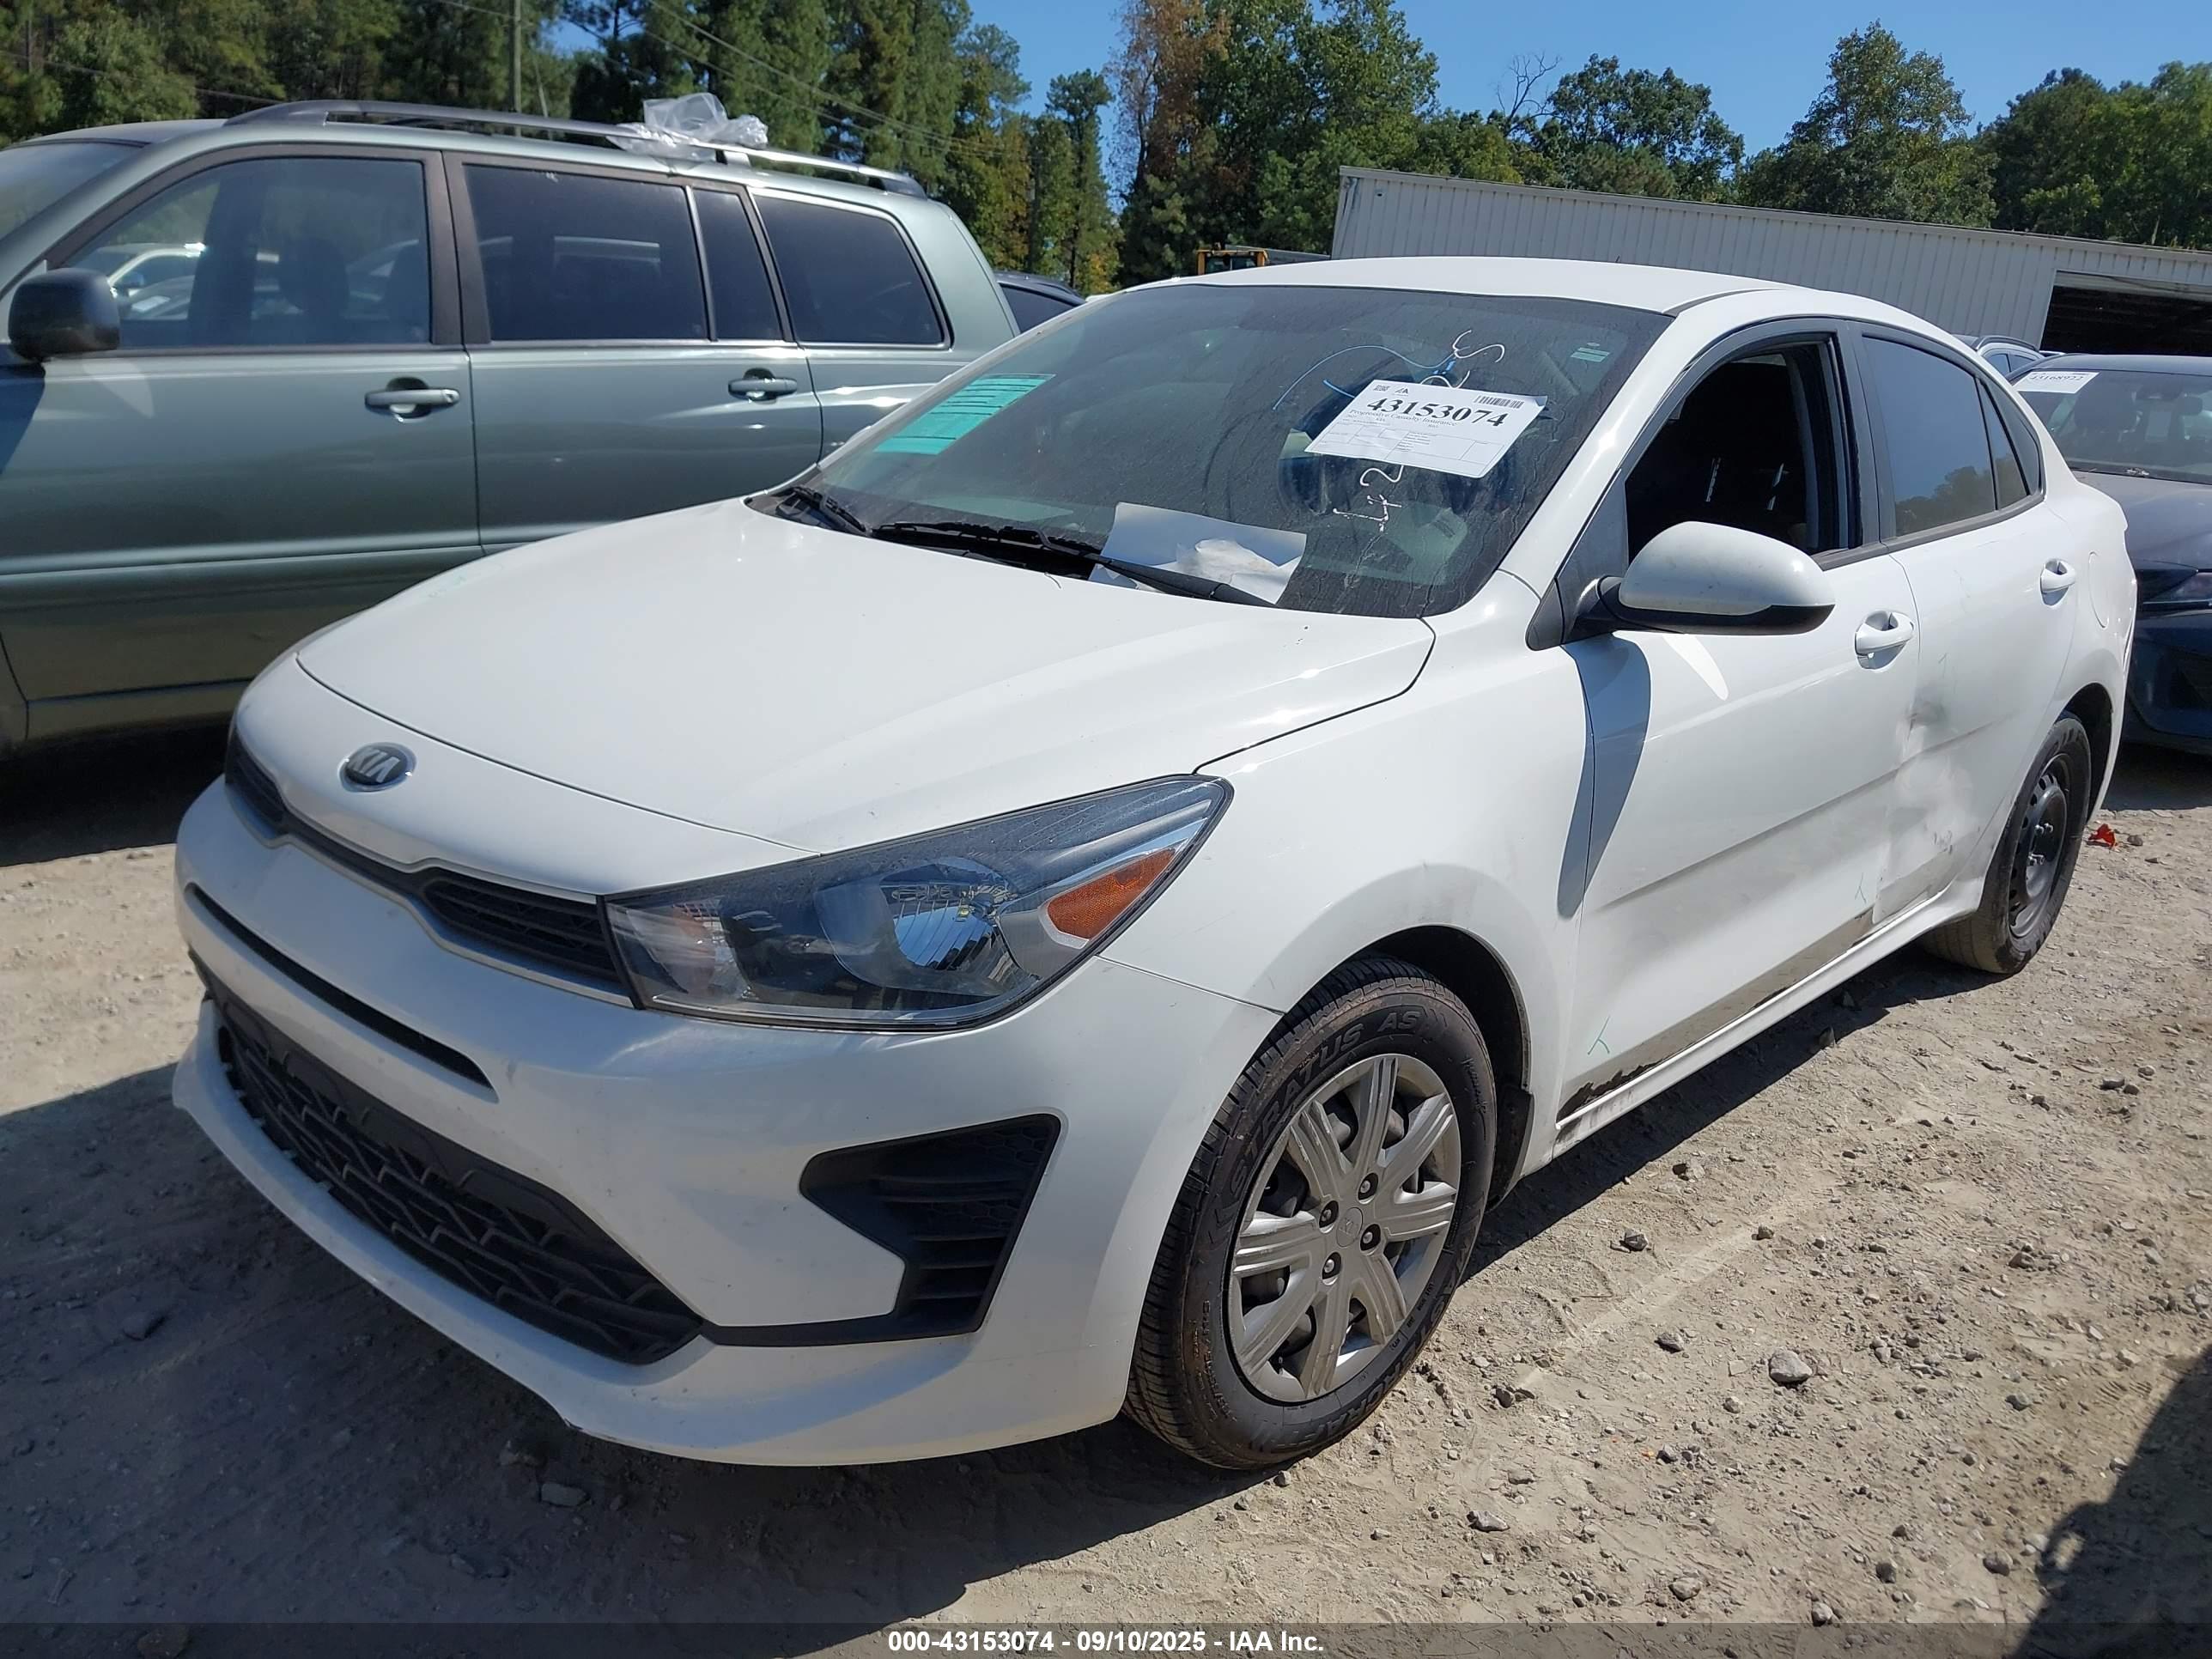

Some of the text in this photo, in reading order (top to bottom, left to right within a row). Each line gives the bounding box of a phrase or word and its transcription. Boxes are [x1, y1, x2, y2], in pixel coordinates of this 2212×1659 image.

[1367, 398, 1509, 427] 43153074
[1230, 1023, 1365, 1194] STRATUS
[1376, 1011, 1422, 1033] AS
